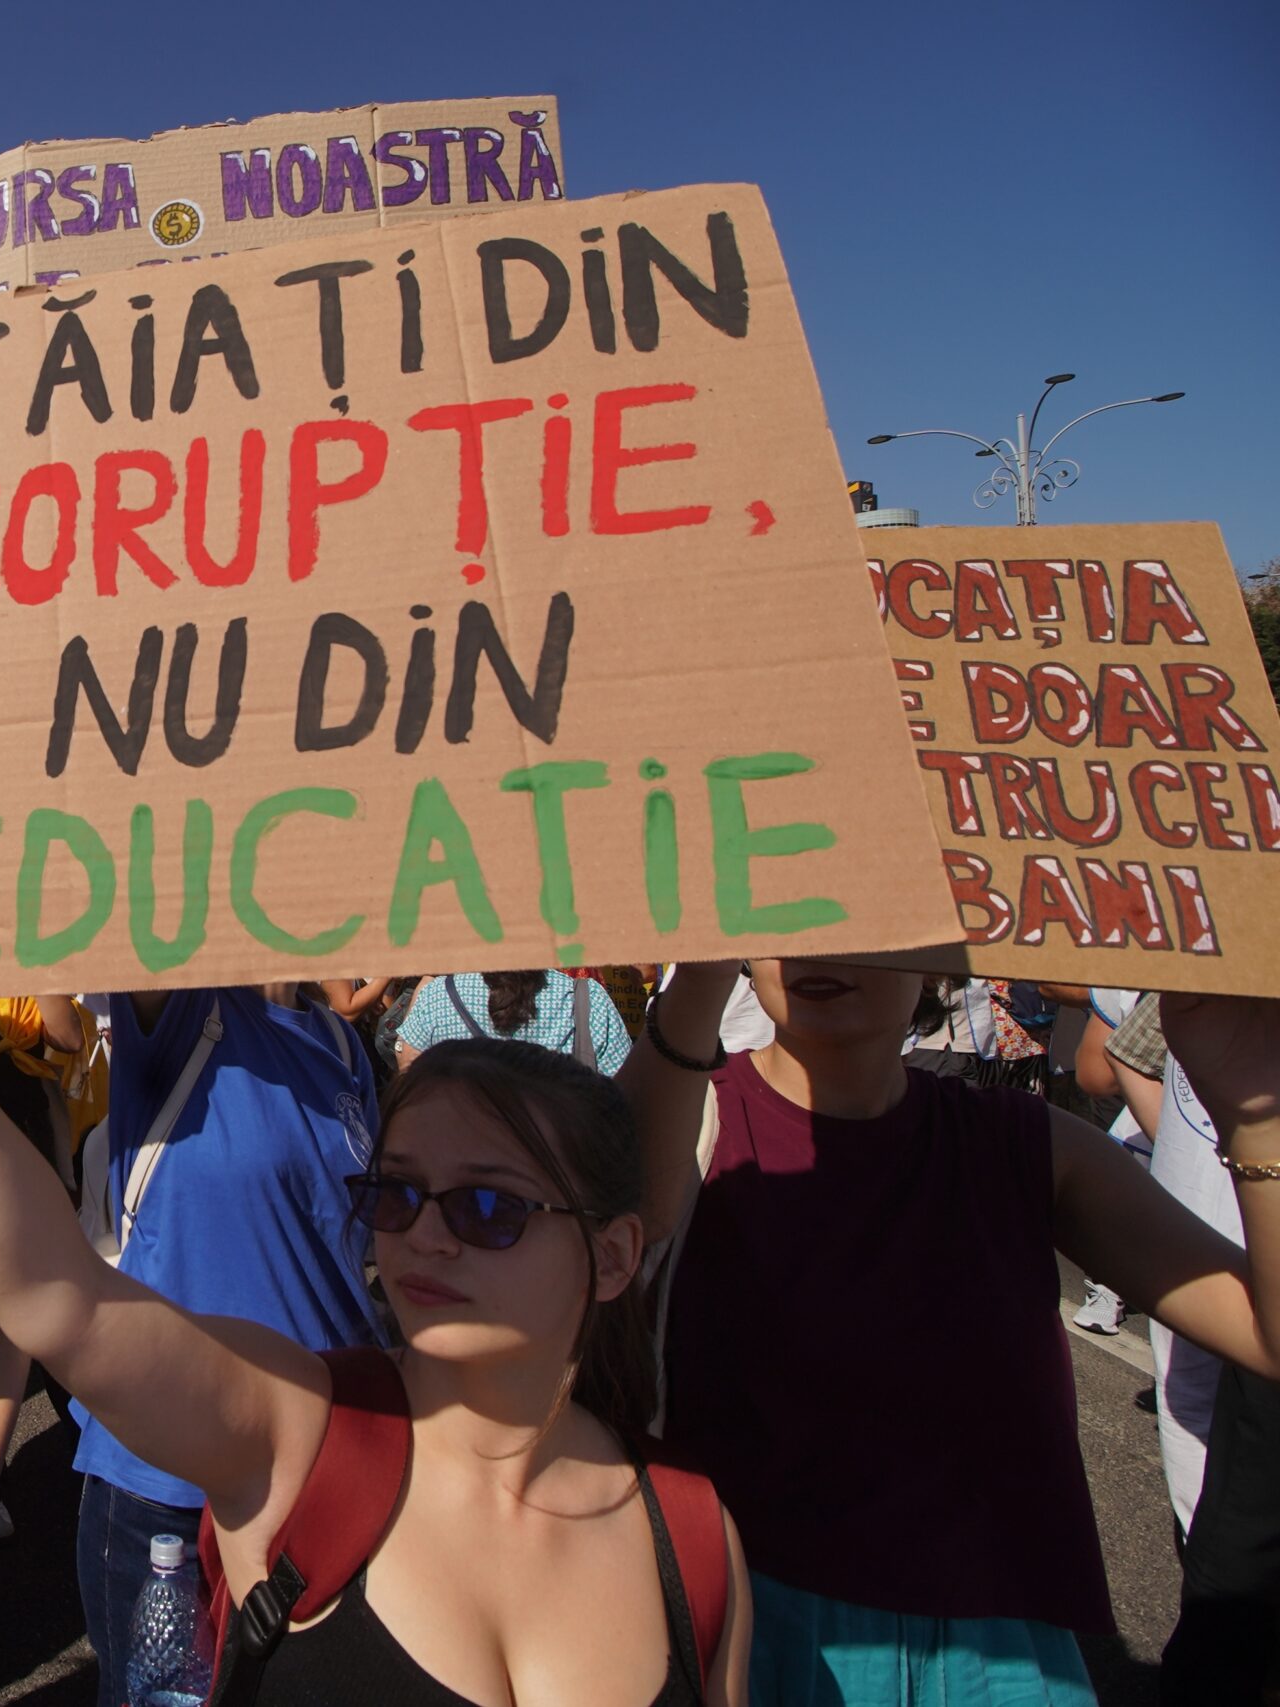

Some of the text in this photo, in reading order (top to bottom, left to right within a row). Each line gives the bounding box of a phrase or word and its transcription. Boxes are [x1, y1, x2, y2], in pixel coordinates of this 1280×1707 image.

[220, 110, 565, 222] NOASTRĂ
[45, 616, 248, 776] NU
[961, 661, 1267, 752] DOAR
[942, 849, 1223, 957] BANI
